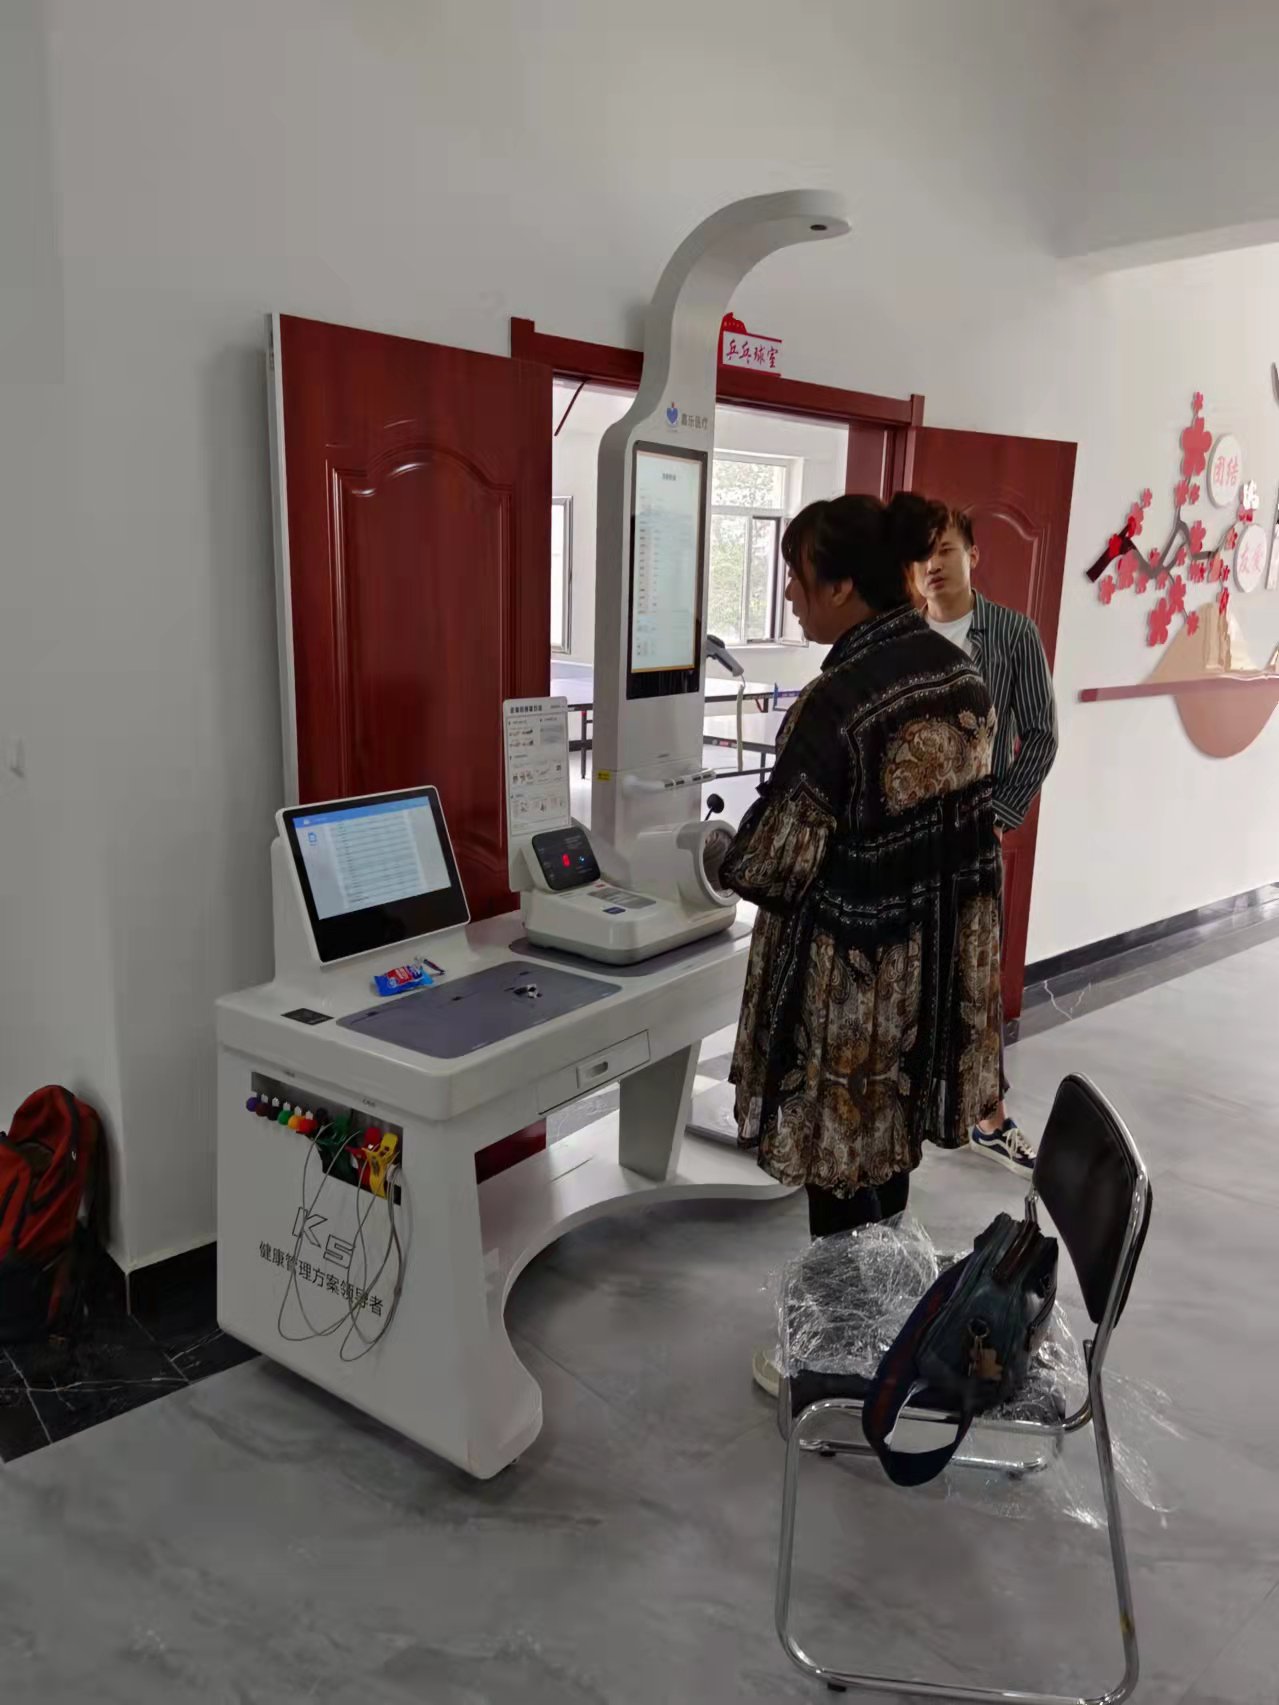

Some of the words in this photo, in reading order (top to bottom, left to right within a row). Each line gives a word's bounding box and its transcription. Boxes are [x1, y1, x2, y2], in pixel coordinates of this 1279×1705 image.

[726, 338, 778, 368] 乒乓球室
[1214, 455, 1239, 486] 团结
[259, 1240, 384, 1317] 健康管理方案领导者
